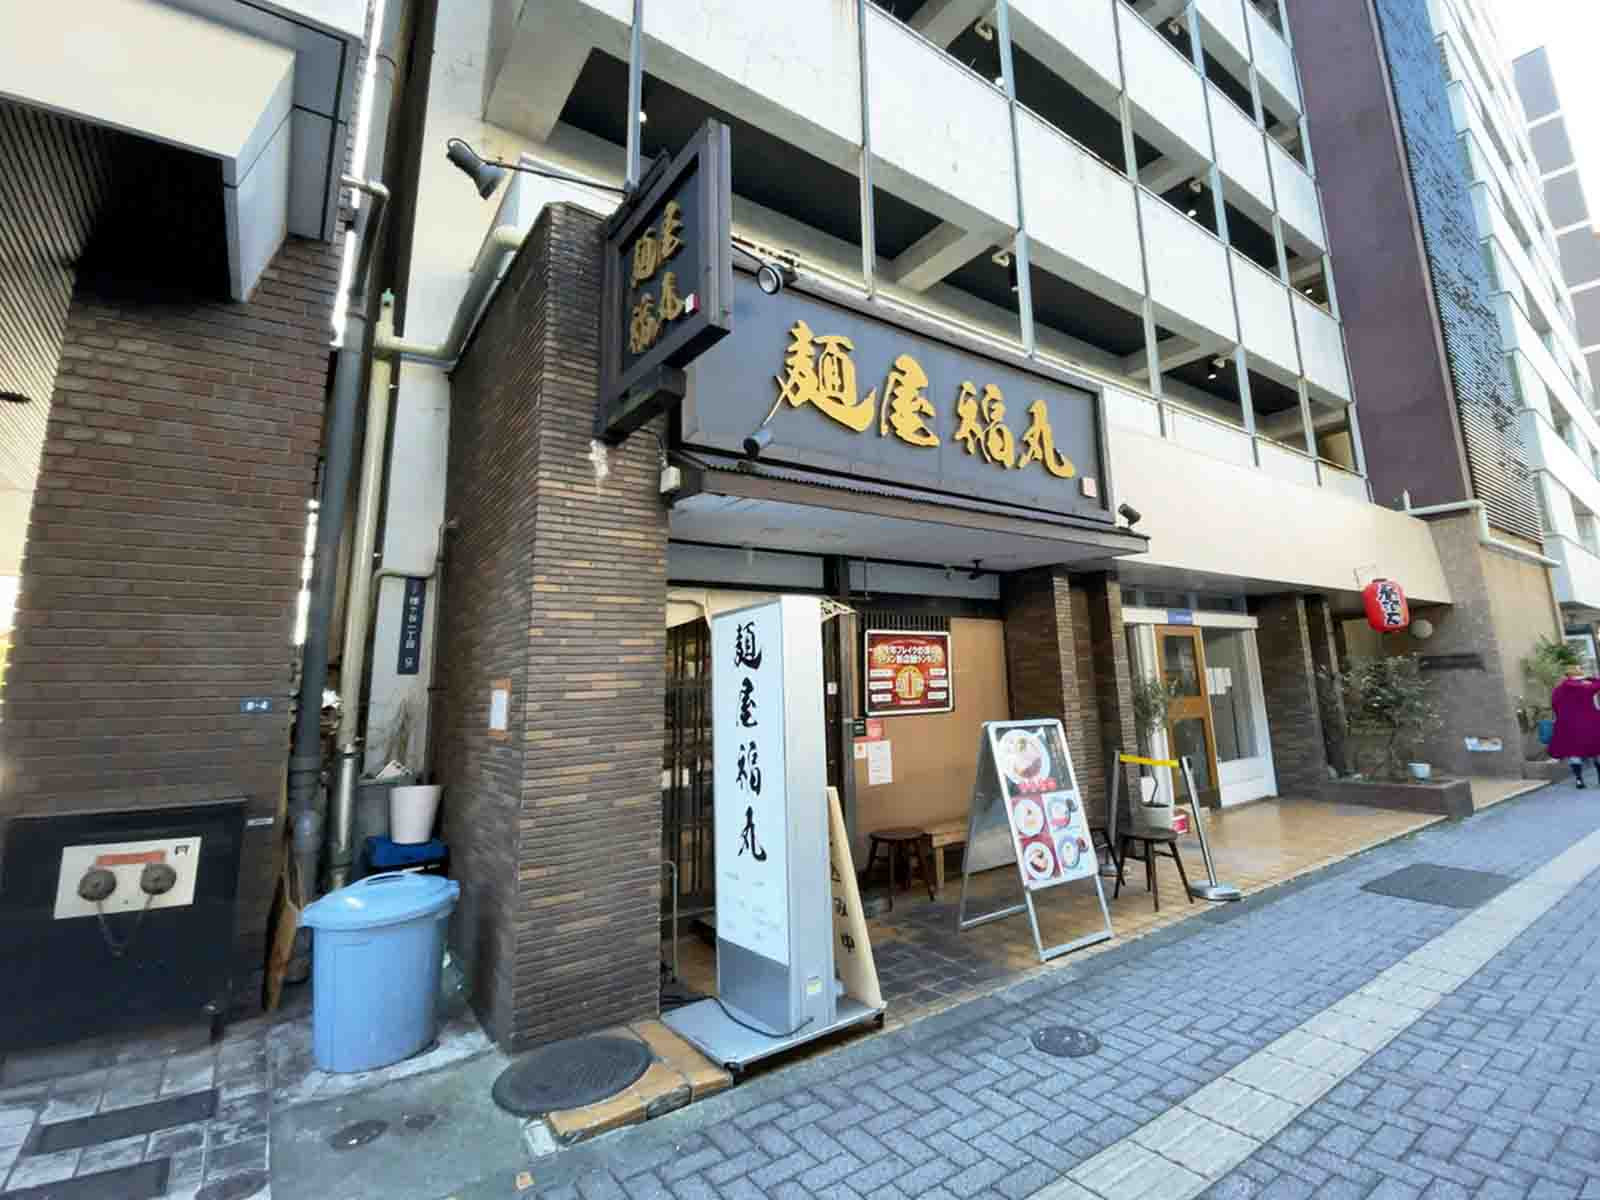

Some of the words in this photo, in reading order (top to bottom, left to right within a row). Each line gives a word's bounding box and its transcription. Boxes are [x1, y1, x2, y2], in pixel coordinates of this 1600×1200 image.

[763, 319, 1076, 479] 麺屋福丸
[734, 621, 768, 862] 麺屋福丸
